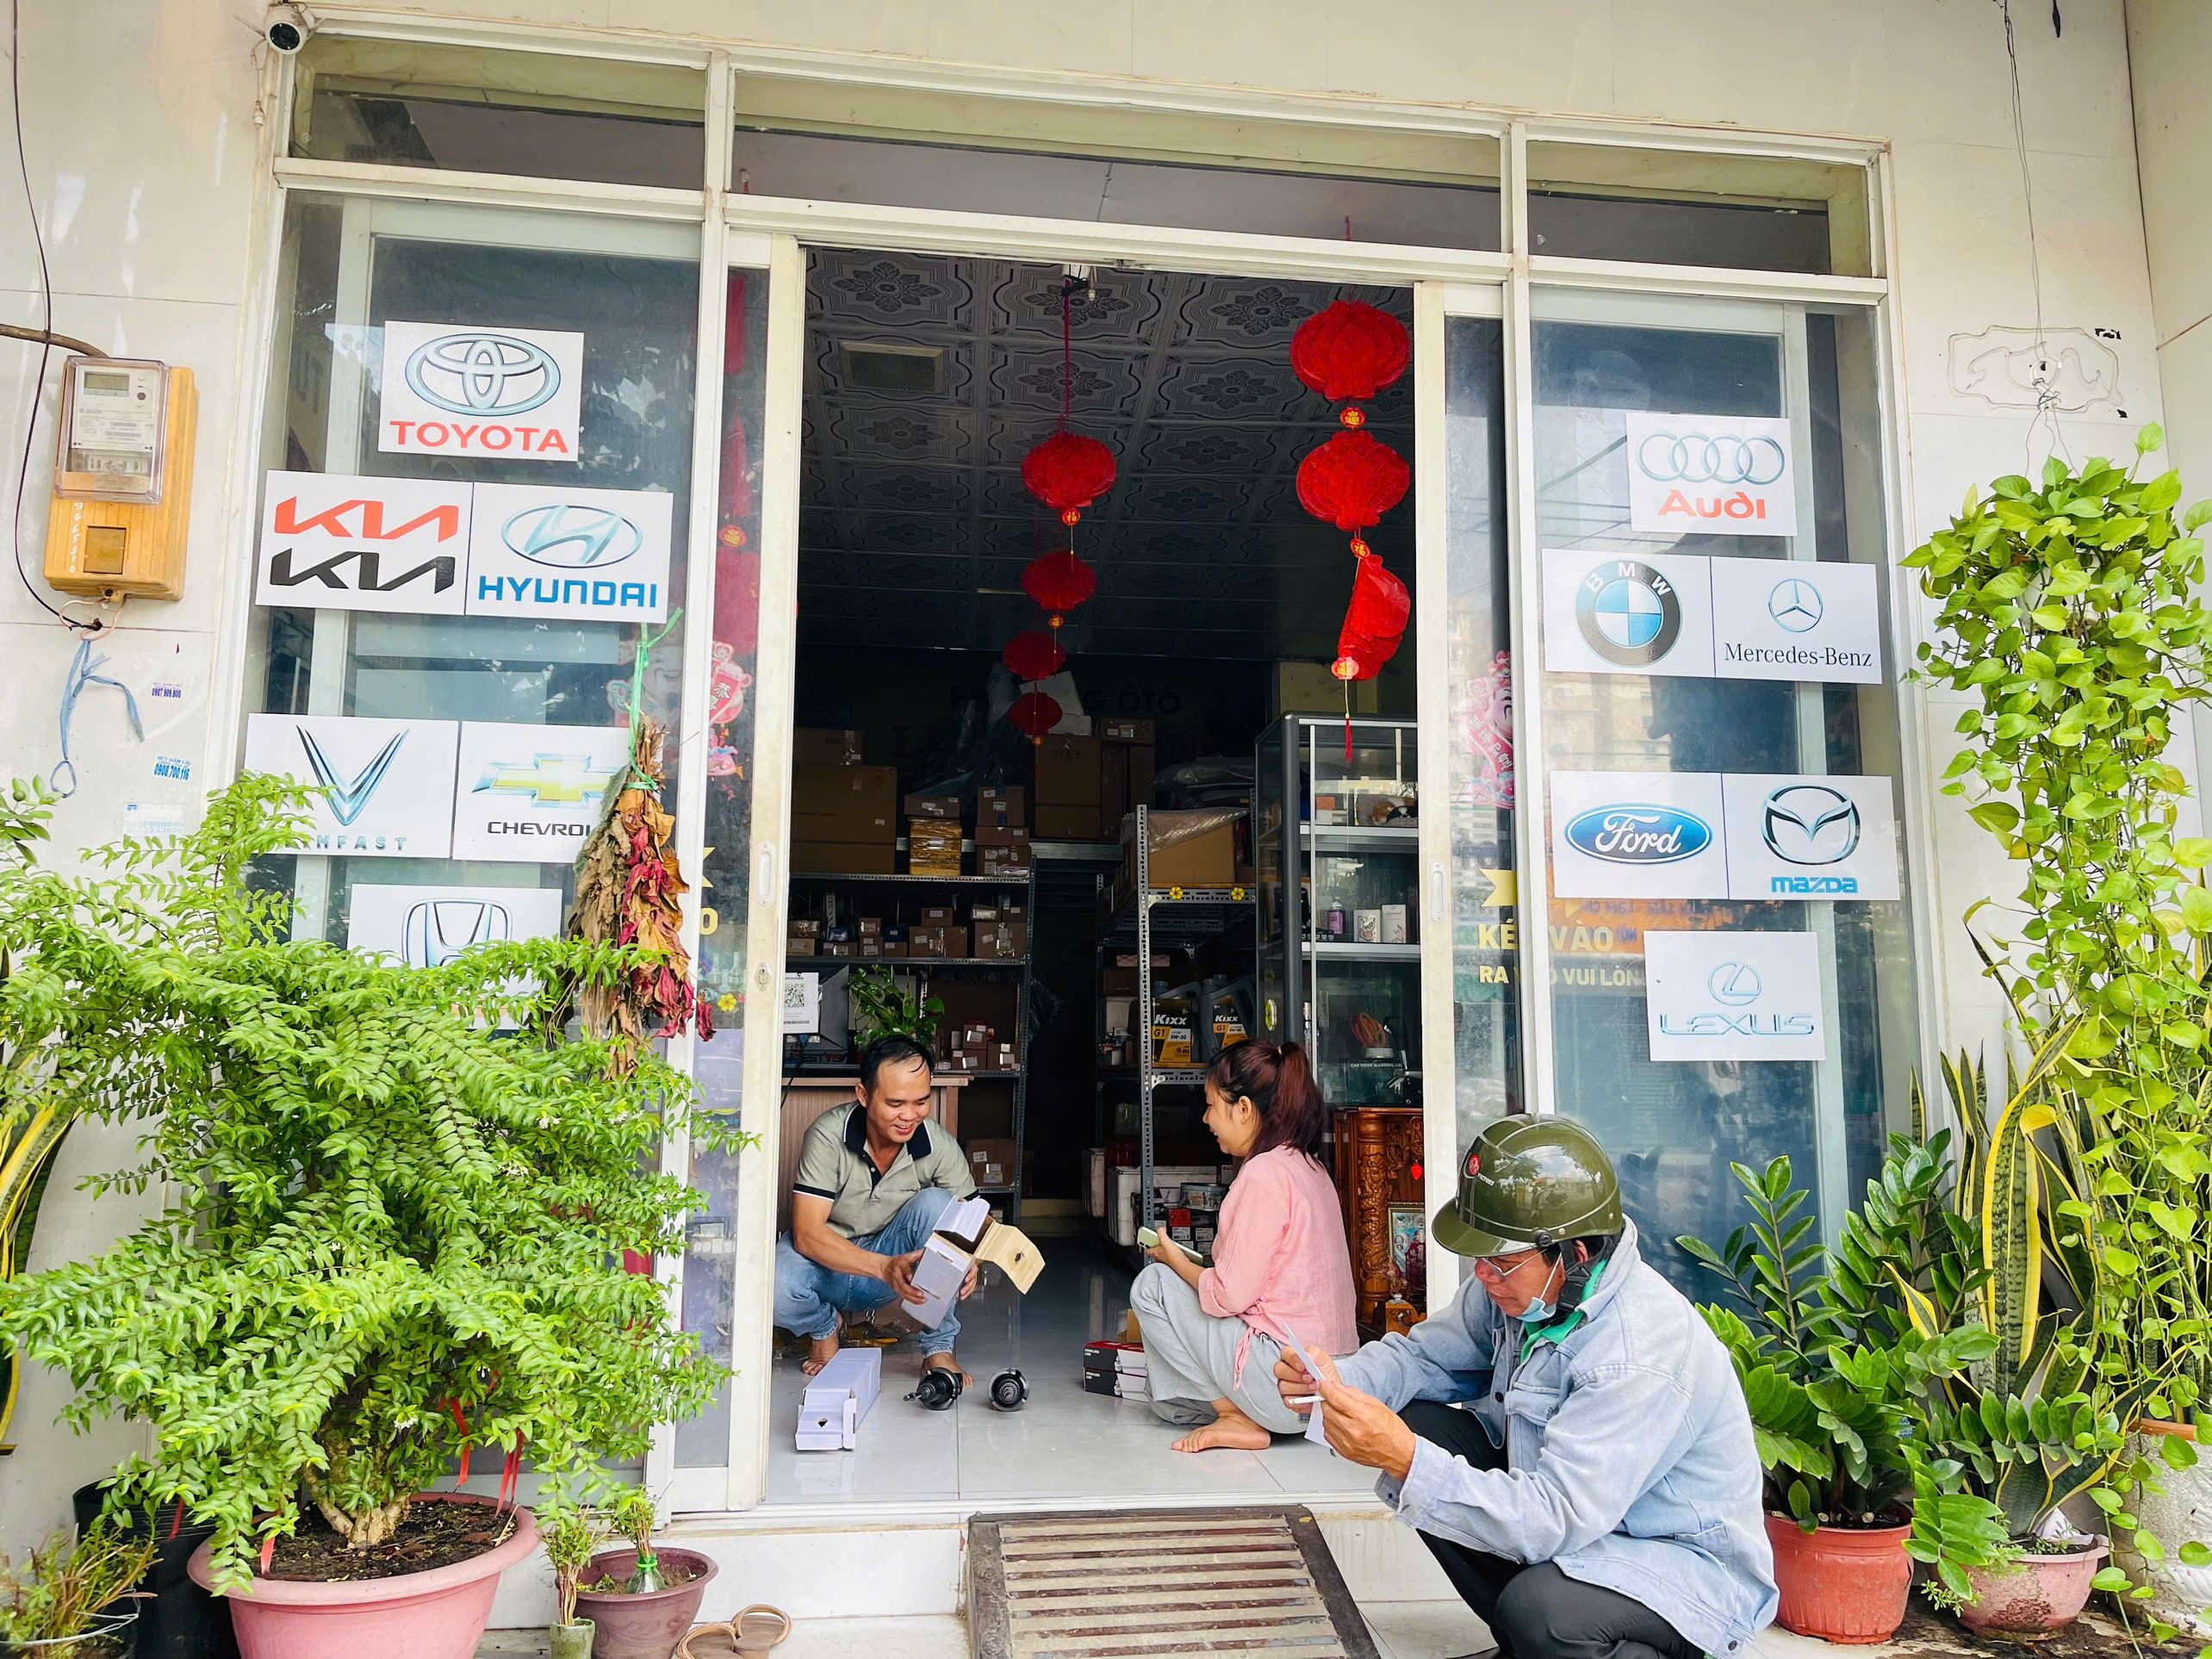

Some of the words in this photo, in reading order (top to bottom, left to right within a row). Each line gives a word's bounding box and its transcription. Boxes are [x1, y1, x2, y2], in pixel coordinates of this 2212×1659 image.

[389, 420, 569, 453] TOYOTA
[1658, 489, 1766, 519] Audi
[274, 496, 459, 544] KIA
[270, 548, 456, 594] KIA
[1585, 562, 1671, 596] BMW
[477, 575, 657, 608] HYUNDAI
[1724, 643, 1873, 668] Mercedes-Benz
[285, 833, 407, 850] NFAST
[488, 822, 591, 836] CHEVRO
[1595, 812, 1683, 854] Ford
[1478, 918, 1519, 951] KÉ
[1550, 919, 1613, 953] VÀO
[1479, 966, 1509, 985] RA
[1563, 967, 1595, 987] VUI
[1153, 1028, 1165, 1037] G1
[1154, 1014, 1188, 1026] Kixx
[1659, 1013, 1815, 1036] LEXUS
